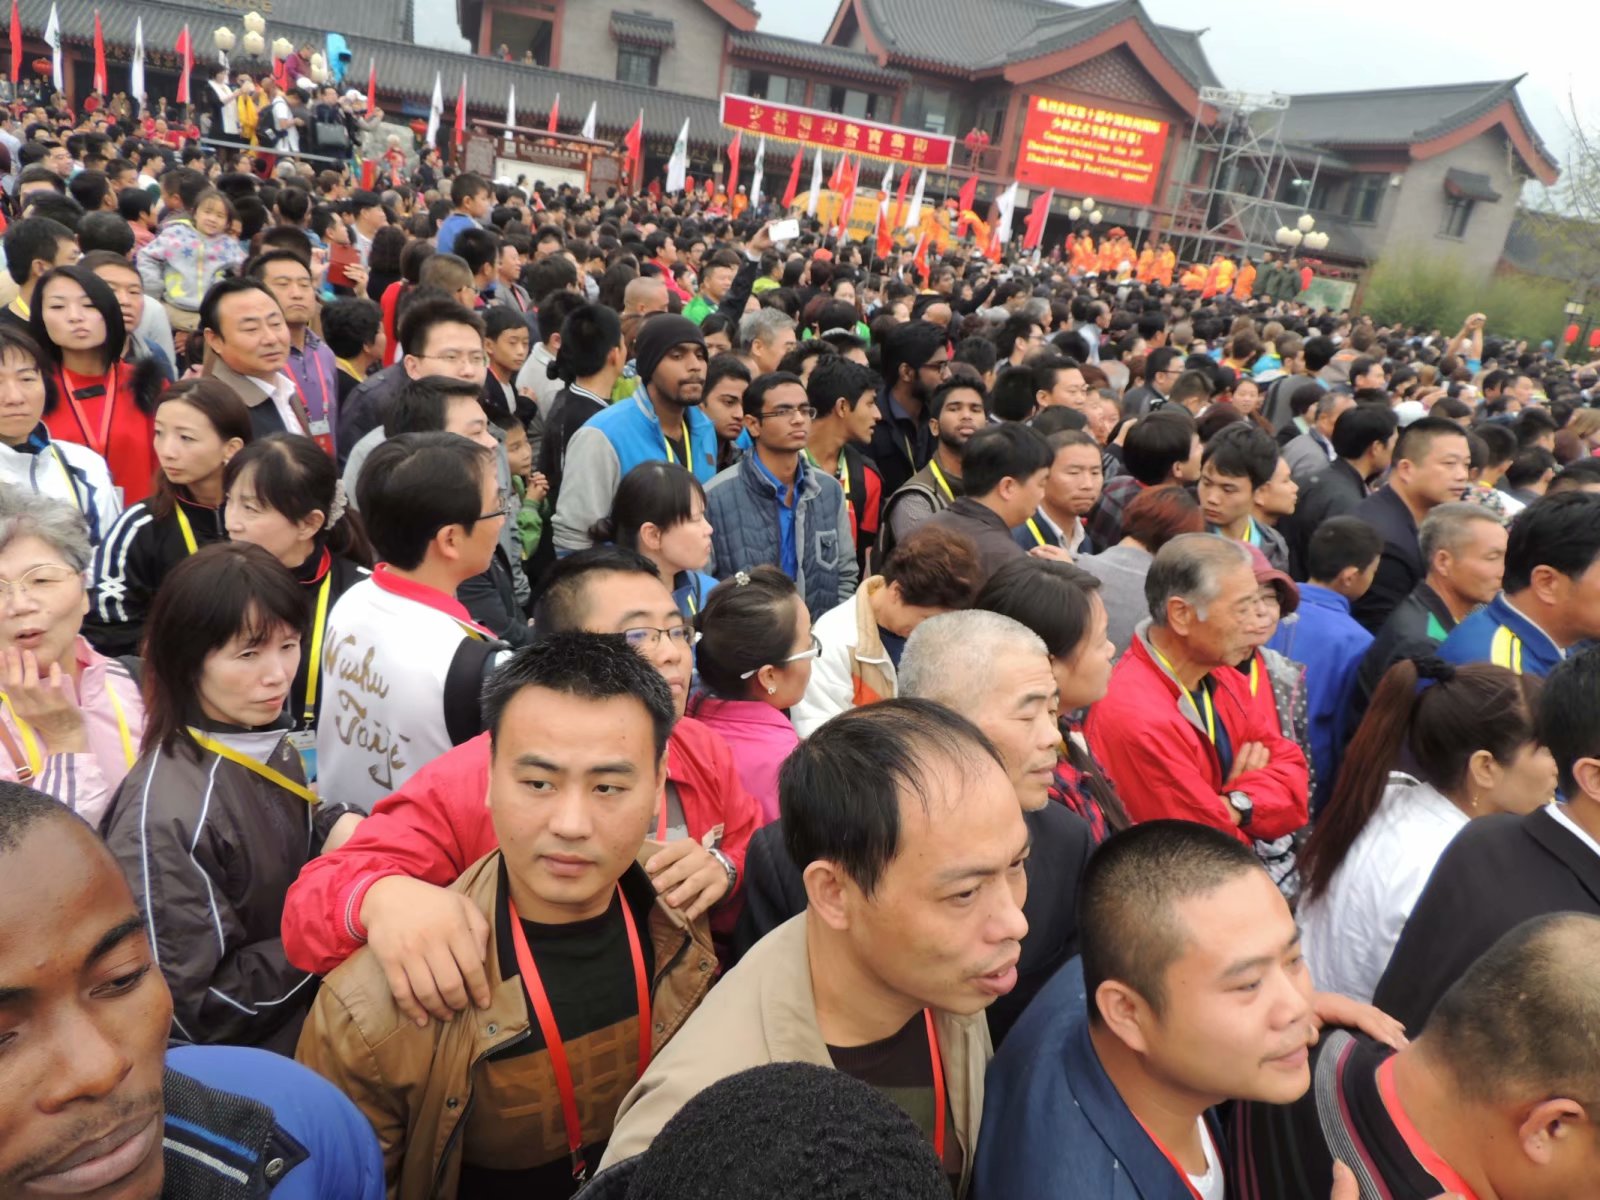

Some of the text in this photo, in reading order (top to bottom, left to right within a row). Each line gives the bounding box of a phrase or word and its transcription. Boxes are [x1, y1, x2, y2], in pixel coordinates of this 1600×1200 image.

[1071, 149, 1095, 163] China
[1097, 152, 1153, 172] International
[324, 626, 390, 699] Wushu
